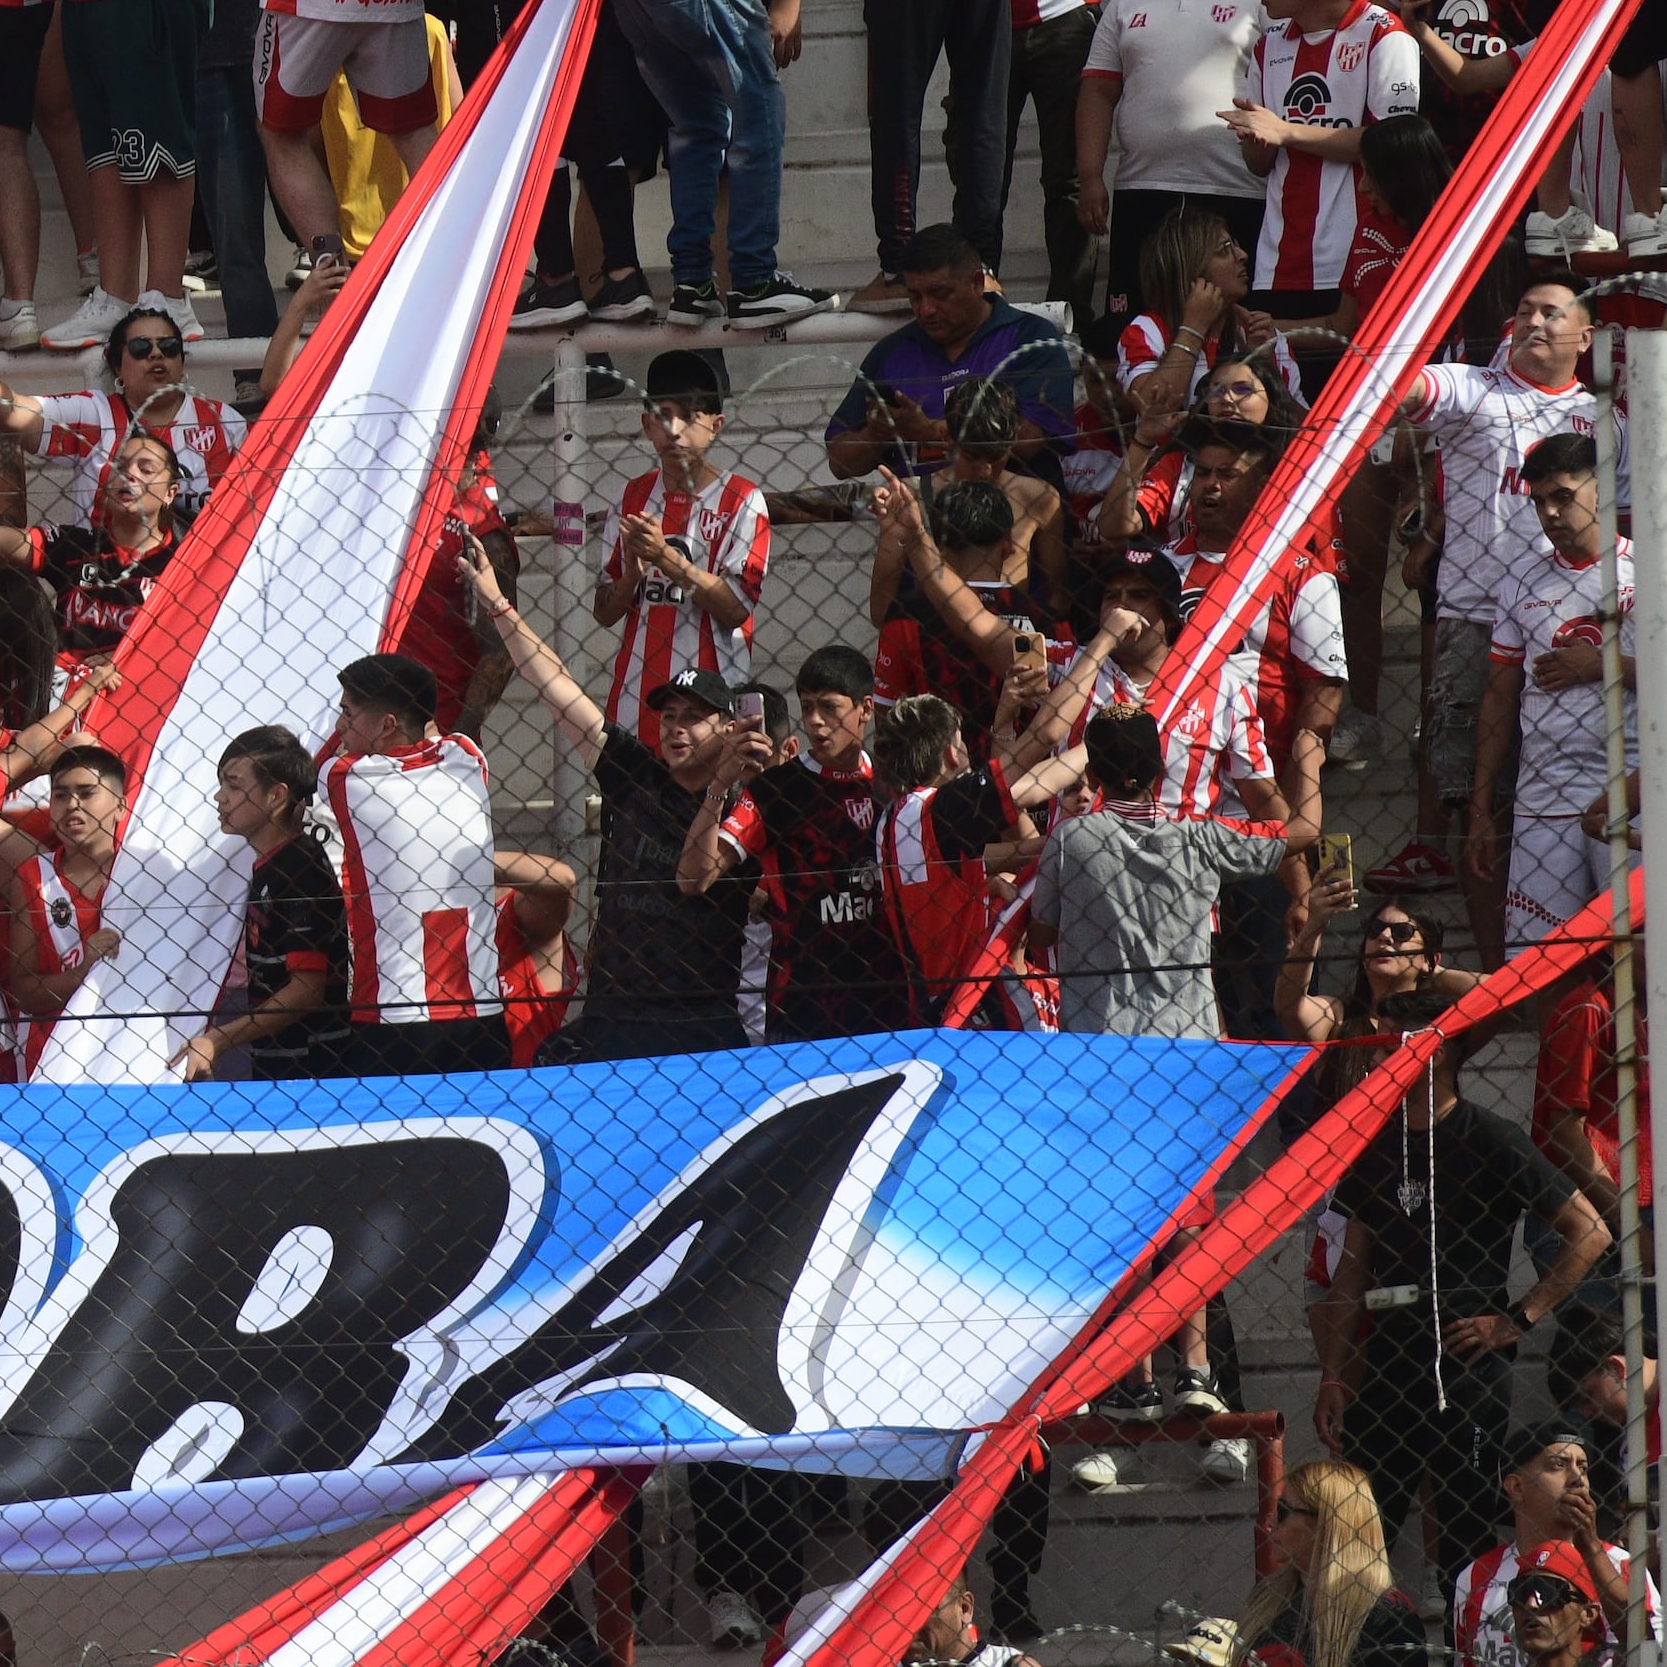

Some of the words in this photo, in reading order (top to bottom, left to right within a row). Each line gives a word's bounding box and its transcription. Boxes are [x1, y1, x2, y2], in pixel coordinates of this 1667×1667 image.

[258, 16, 273, 86] GIVOVA
[1524, 599, 1563, 611] GIVOVA
[819, 892, 874, 925] Mac
[1472, 1426, 1482, 1469] KELME
